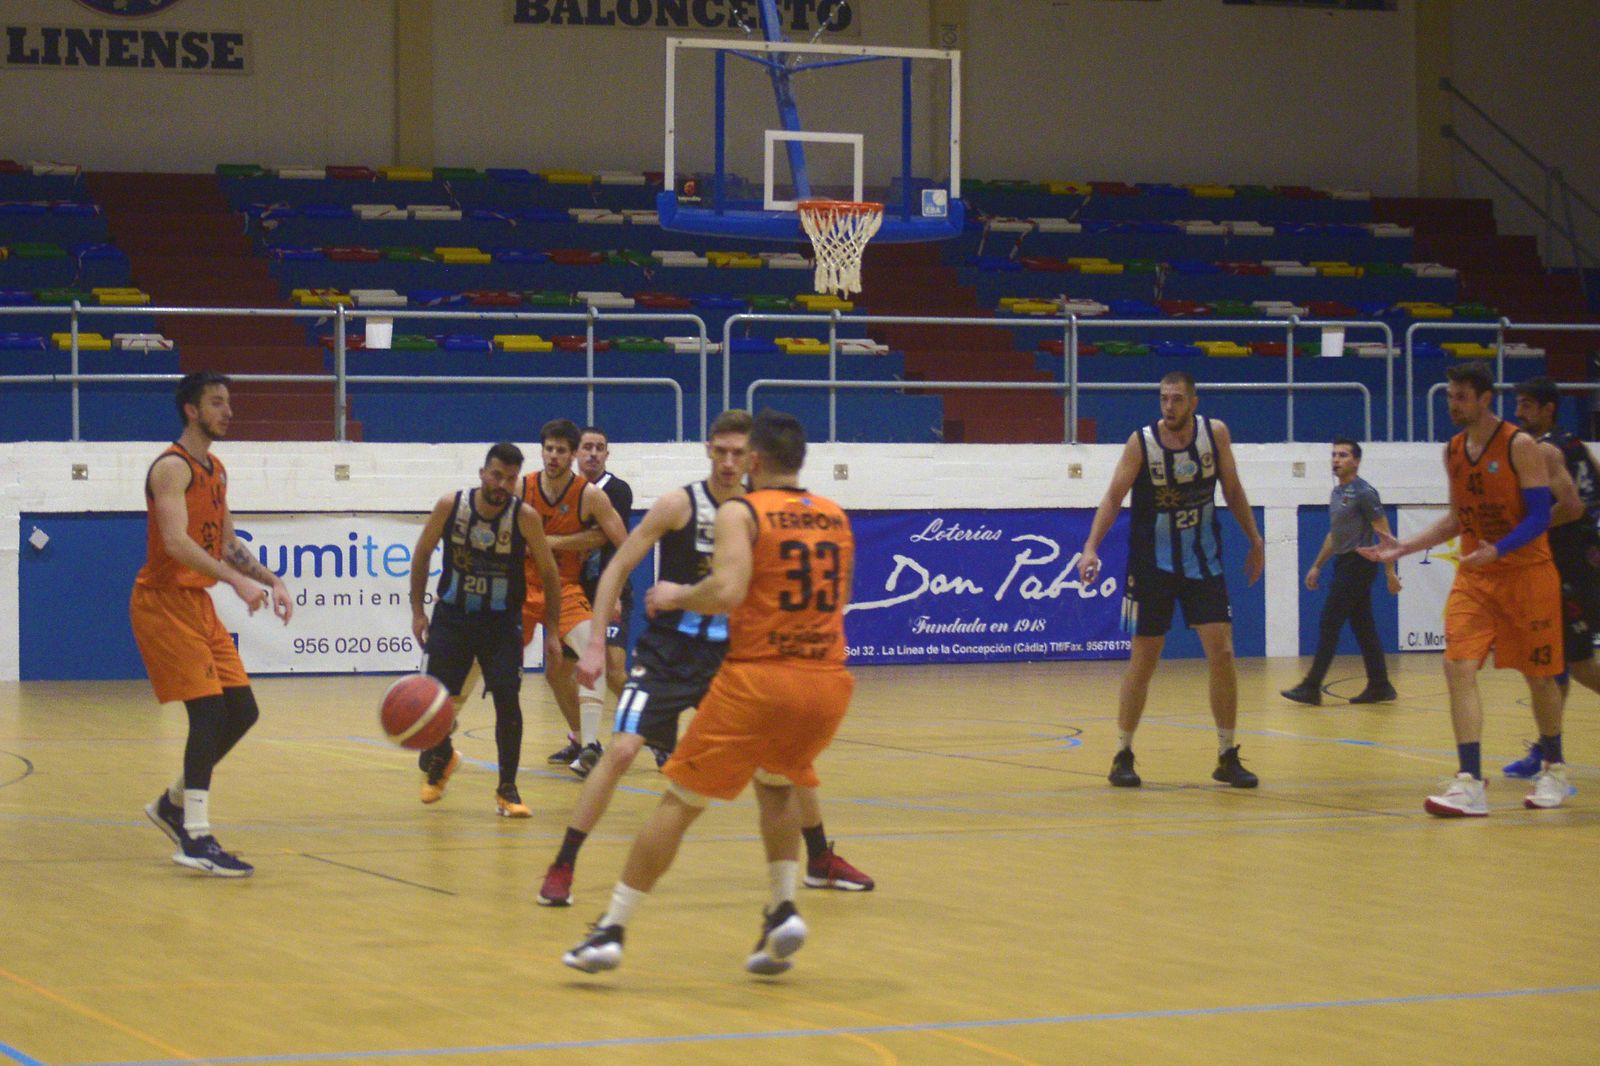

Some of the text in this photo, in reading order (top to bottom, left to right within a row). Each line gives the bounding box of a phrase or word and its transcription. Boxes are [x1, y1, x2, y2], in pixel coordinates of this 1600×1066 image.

[513, 0, 852, 32] BALONCETO
[6, 27, 244, 69] LINENSE
[1175, 508, 1199, 529] 23
[909, 517, 1003, 543] Loterías
[463, 575, 488, 595] 20
[779, 539, 841, 613] 33
[911, 615, 987, 634] Fundada
[989, 621, 1009, 633] en
[293, 636, 413, 654] 956 020 666
[844, 645, 860, 656] Sol
[862, 645, 875, 656] 32
[881, 645, 895, 655] La
[926, 643, 939, 655] de
[940, 643, 950, 655] la
[952, 642, 1012, 656] Concepción
[1013, 641, 1048, 655] (Cádiz)
[1529, 645, 1552, 666] 43
